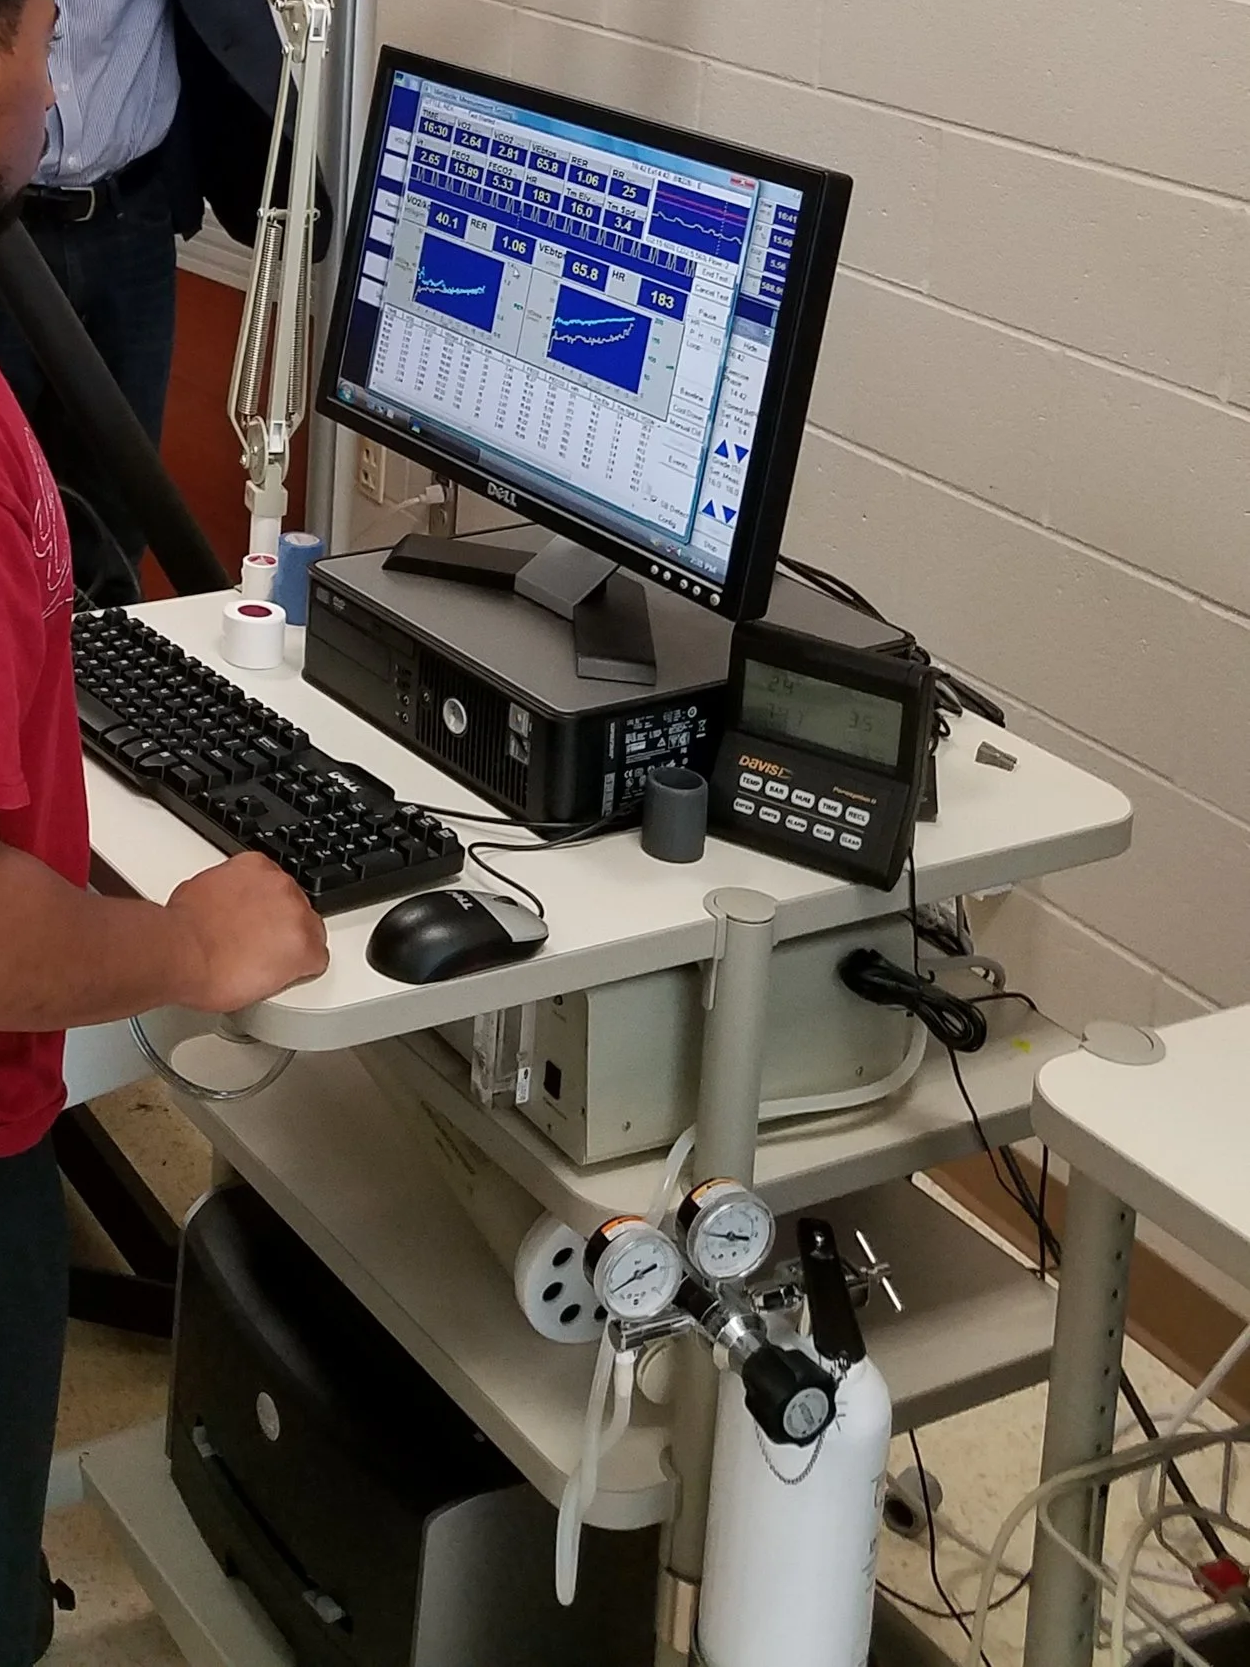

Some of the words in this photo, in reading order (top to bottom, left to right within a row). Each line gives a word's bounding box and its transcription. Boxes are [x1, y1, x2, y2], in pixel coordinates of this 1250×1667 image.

[423, 109, 439, 121] TIME
[423, 120, 449, 137] 16:30
[457, 120, 472, 131] VO2
[461, 133, 482, 149] 2.64
[494, 130, 514, 144] VCO2
[420, 150, 441, 166] 2.65
[499, 145, 519, 161] 2.81
[536, 157, 559, 173] 65.8
[571, 156, 589, 167] RER
[453, 162, 479, 179] 15.89
[576, 170, 599, 186] 1.06
[612, 169, 625, 179] RR
[492, 175, 514, 191] 5.33
[526, 175, 538, 184] HR
[532, 188, 551, 204] 183
[622, 184, 637, 199] 25
[571, 202, 593, 218] 16.0
[435, 211, 459, 229] 40.1
[470, 218, 488, 232] RER
[614, 216, 632, 232] 3.4
[502, 235, 527, 254] 1.06
[571, 261, 600, 281] 65.8
[612, 269, 626, 282] HR
[651, 290, 675, 309] 183
[487, 481, 517, 507] DELL
[327, 771, 363, 793] DELL
[742, 776, 760, 787] TEMP
[769, 785, 784, 795] BAR
[822, 802, 839, 813] TIME
